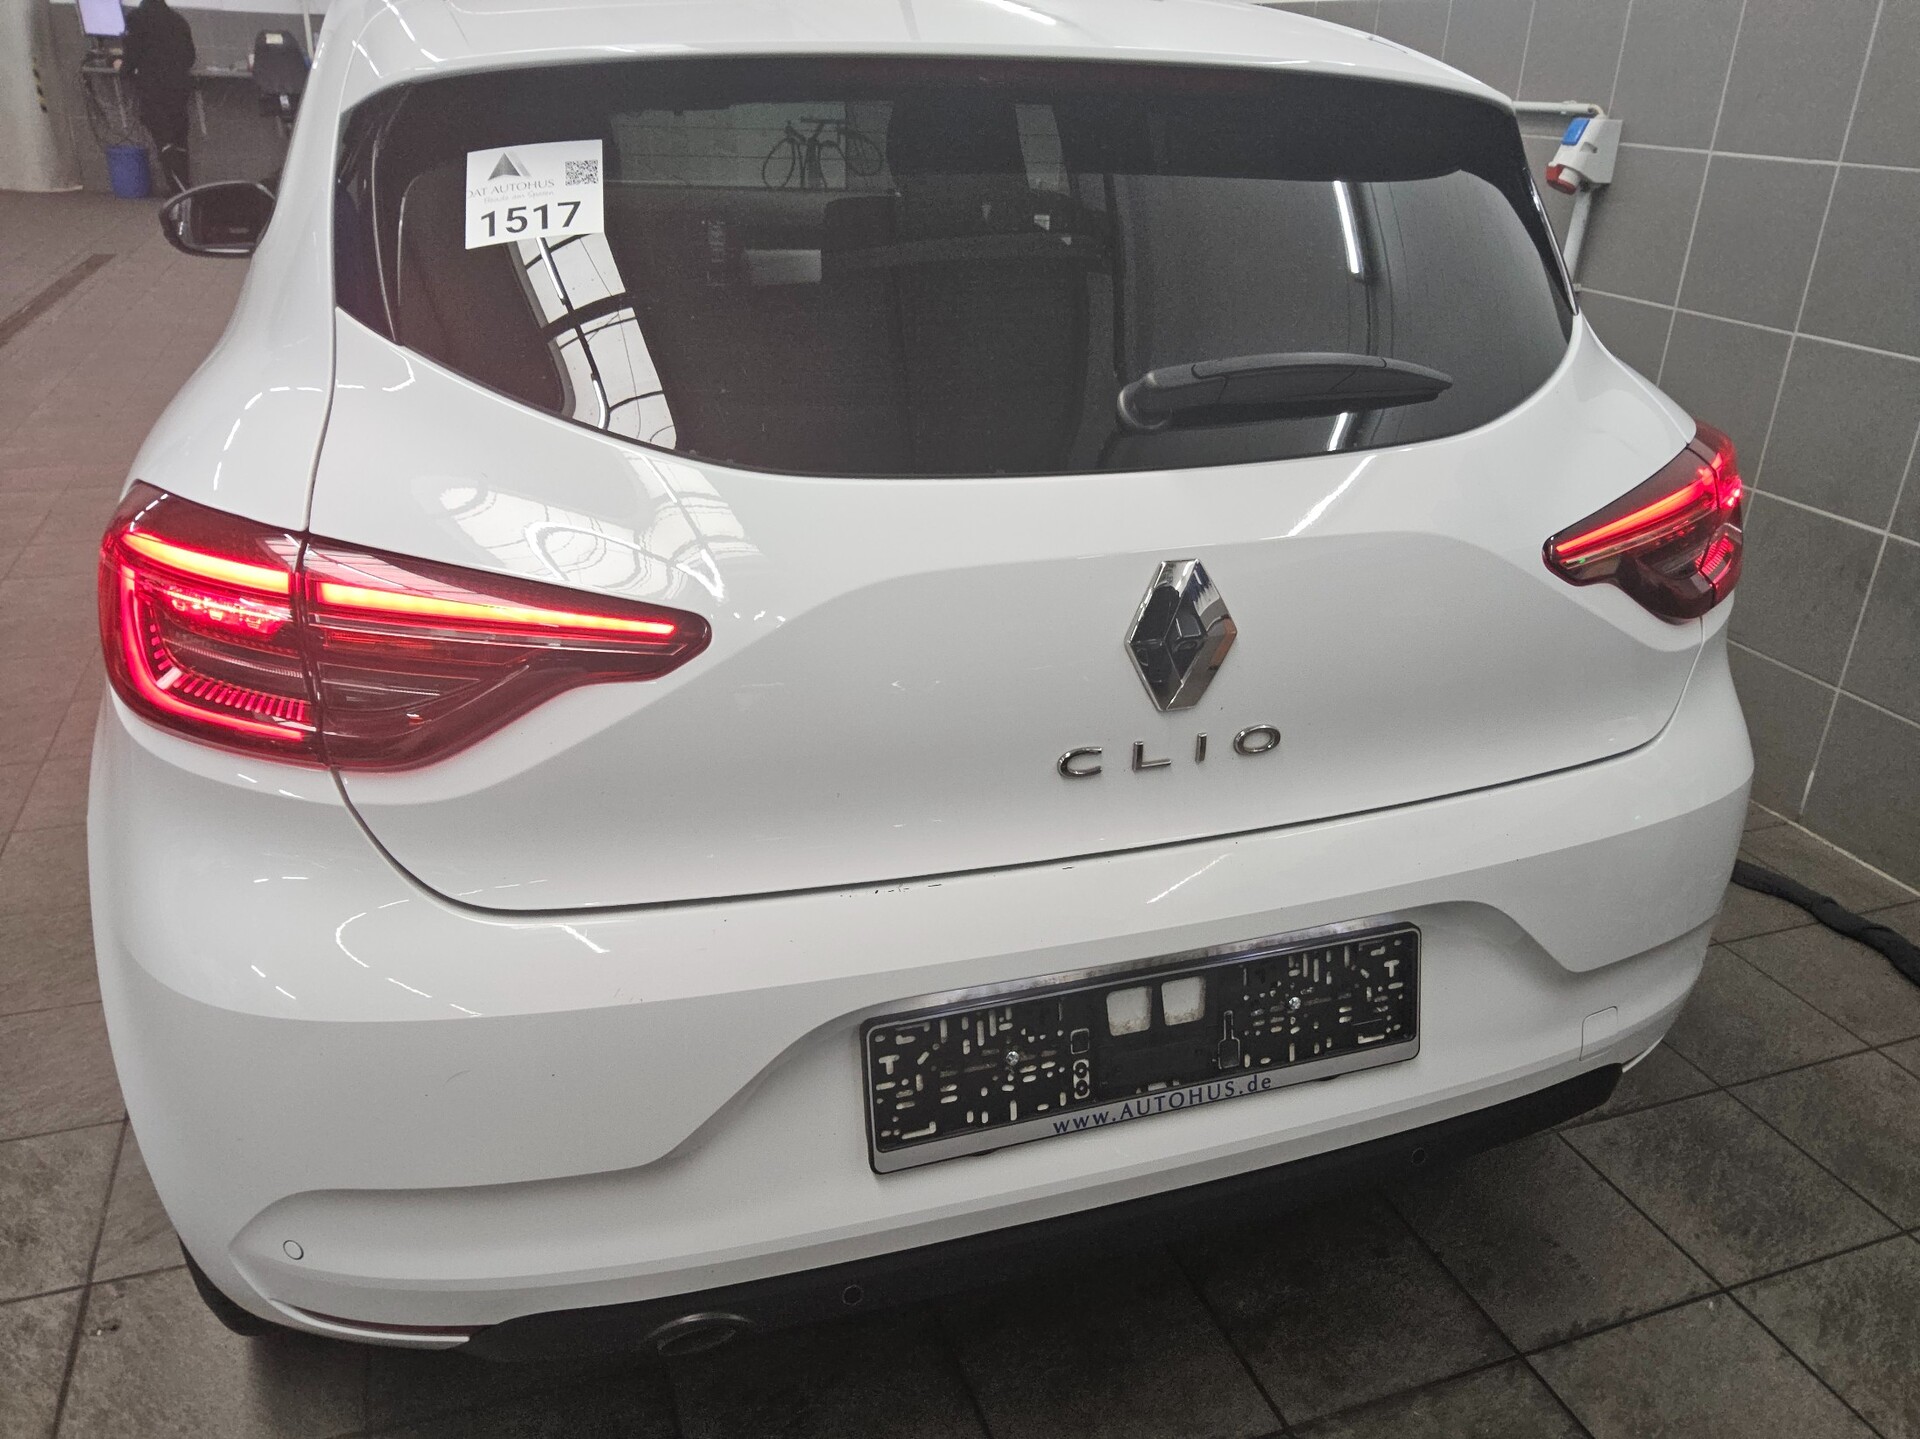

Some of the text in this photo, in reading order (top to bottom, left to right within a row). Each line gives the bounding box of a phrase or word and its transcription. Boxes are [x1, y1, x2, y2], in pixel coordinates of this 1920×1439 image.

[491, 179, 555, 194] AUTOHUS
[481, 201, 582, 237] 1517
[1057, 724, 1281, 778] CLIO
[1053, 1075, 1272, 1134] www.AUTOHUS.de
